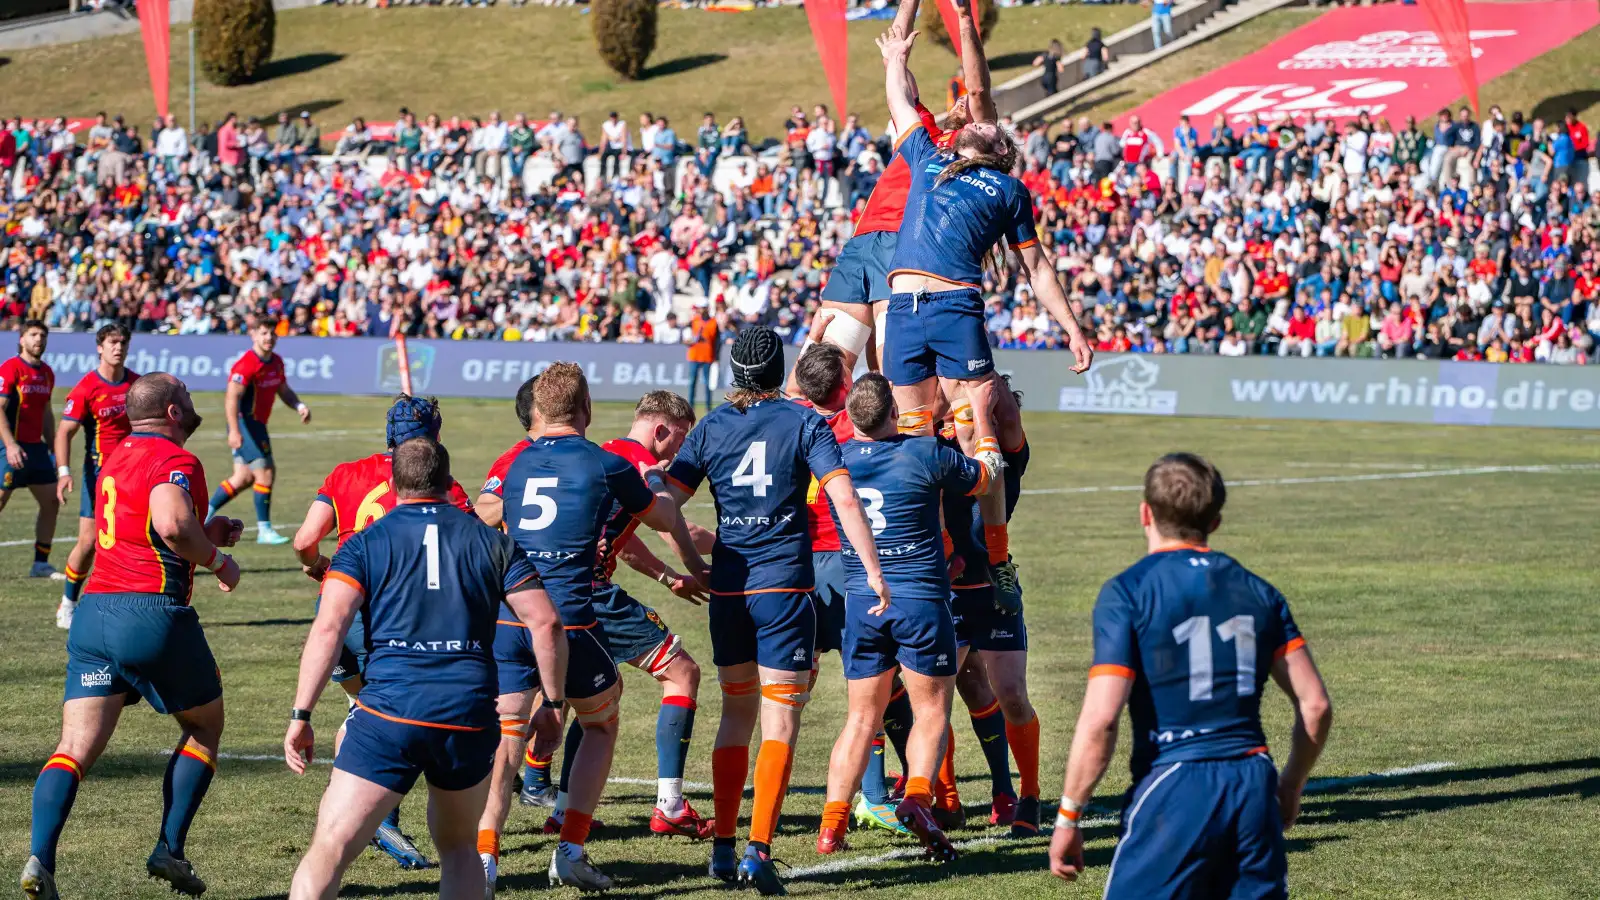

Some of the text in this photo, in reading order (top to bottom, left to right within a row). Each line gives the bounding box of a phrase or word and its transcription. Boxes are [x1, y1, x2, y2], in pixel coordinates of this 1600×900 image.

[613, 362, 690, 386] BALL
[1230, 376, 1600, 412] www.rhino.dire
[731, 441, 773, 497] 4
[98, 476, 117, 550] 3
[353, 480, 390, 532] 6
[518, 477, 559, 531] 5
[720, 513, 793, 525] MATRIX
[422, 524, 440, 590] 1
[525, 550, 579, 560] TRIX
[388, 639, 483, 651] MATRIX
[1172, 614, 1257, 702] 11
